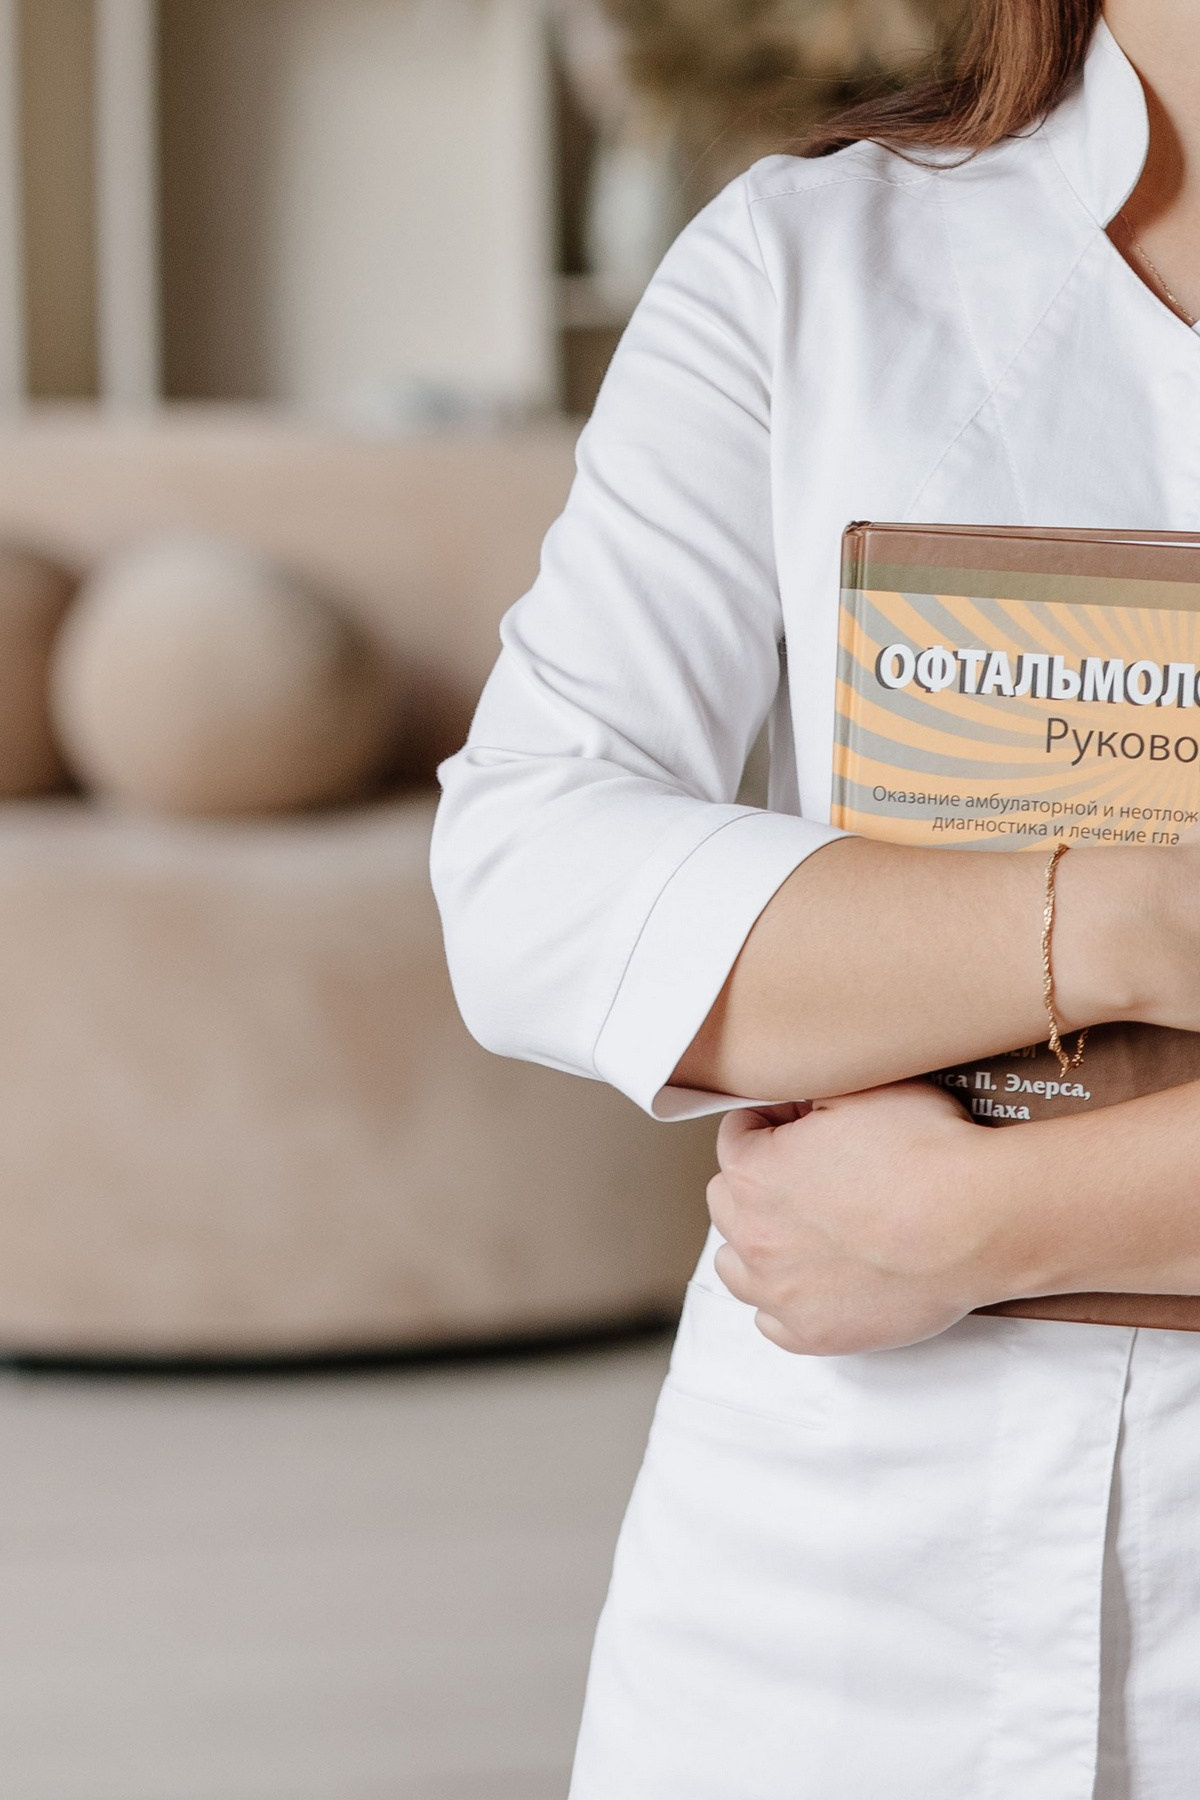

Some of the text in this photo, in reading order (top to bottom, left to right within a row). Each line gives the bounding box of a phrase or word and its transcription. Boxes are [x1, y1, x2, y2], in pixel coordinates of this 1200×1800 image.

[872, 785, 961, 808] Оказание
[964, 792, 1098, 818] амбулаторной
[1103, 804, 1115, 818] и
[931, 816, 1048, 837] диагностика
[1053, 824, 1065, 838] и
[1068, 825, 1147, 844] лечение
[974, 1071, 998, 1091] П.
[1004, 1072, 1091, 1101] Элерса,
[971, 1097, 1031, 1121] Шаха
